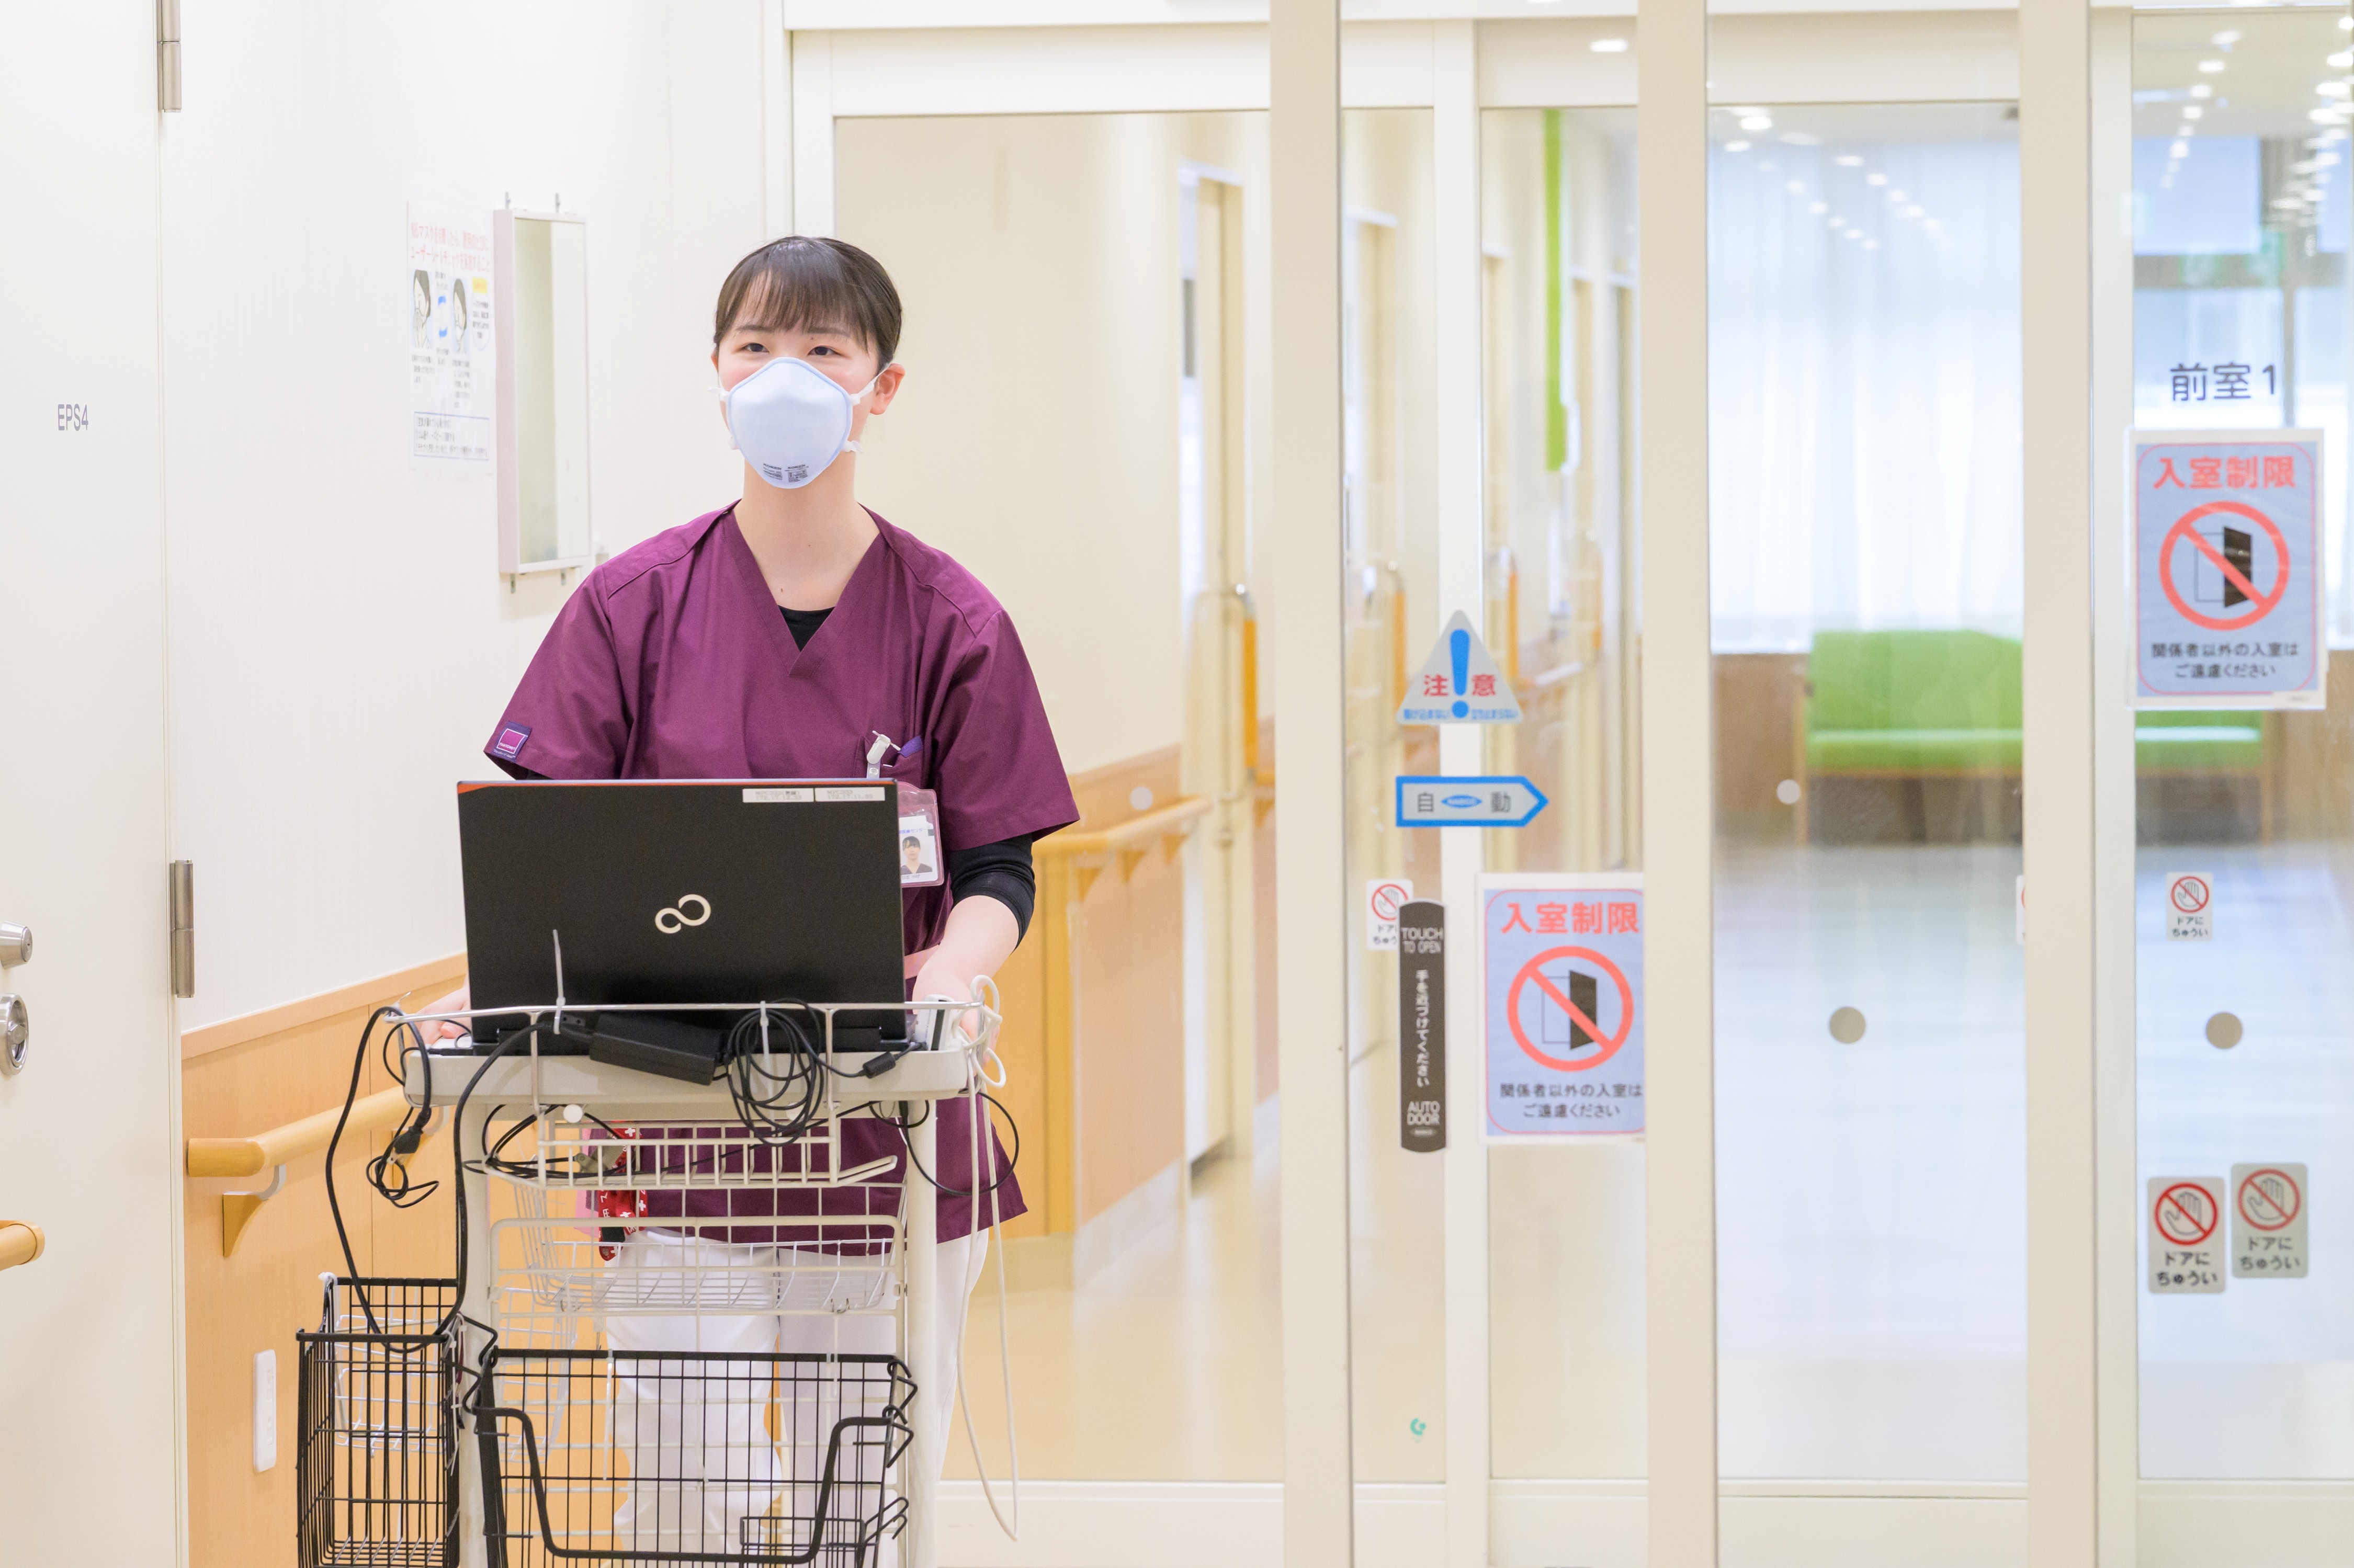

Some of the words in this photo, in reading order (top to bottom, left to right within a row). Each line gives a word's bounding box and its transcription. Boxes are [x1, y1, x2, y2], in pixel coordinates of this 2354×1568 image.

[2170, 362, 2276, 401] 前室1
[58, 404, 88, 431] EPS4
[2153, 456, 2296, 490] 入室制限
[2151, 642, 2298, 657] 関係者以外の入室は
[2175, 663, 2276, 678] ご遠慮ください
[1501, 901, 1639, 935] 入室制限
[2178, 916, 2204, 925] ドアに
[1378, 924, 1397, 933] ドア
[1401, 927, 1444, 940] TOUCH
[2172, 928, 2208, 937] ちゅうい
[1373, 935, 1397, 945] ちゅう
[1404, 941, 1416, 953] TO
[1418, 940, 1441, 954] OPEN
[1415, 969, 1430, 1087] 手を近づけてください
[1500, 1083, 1643, 1098] 関係者以外の入室は
[1408, 1101, 1441, 1113] AUTO
[1523, 1104, 1620, 1118] ご遠慮ください
[1407, 1112, 1440, 1126] DOOR
[2249, 1236, 2293, 1251] ドアに
[2165, 1252, 2210, 1266] ドアに
[2240, 1256, 2300, 1270] ちゅうい
[2156, 1271, 2218, 1286] ちゅうい
